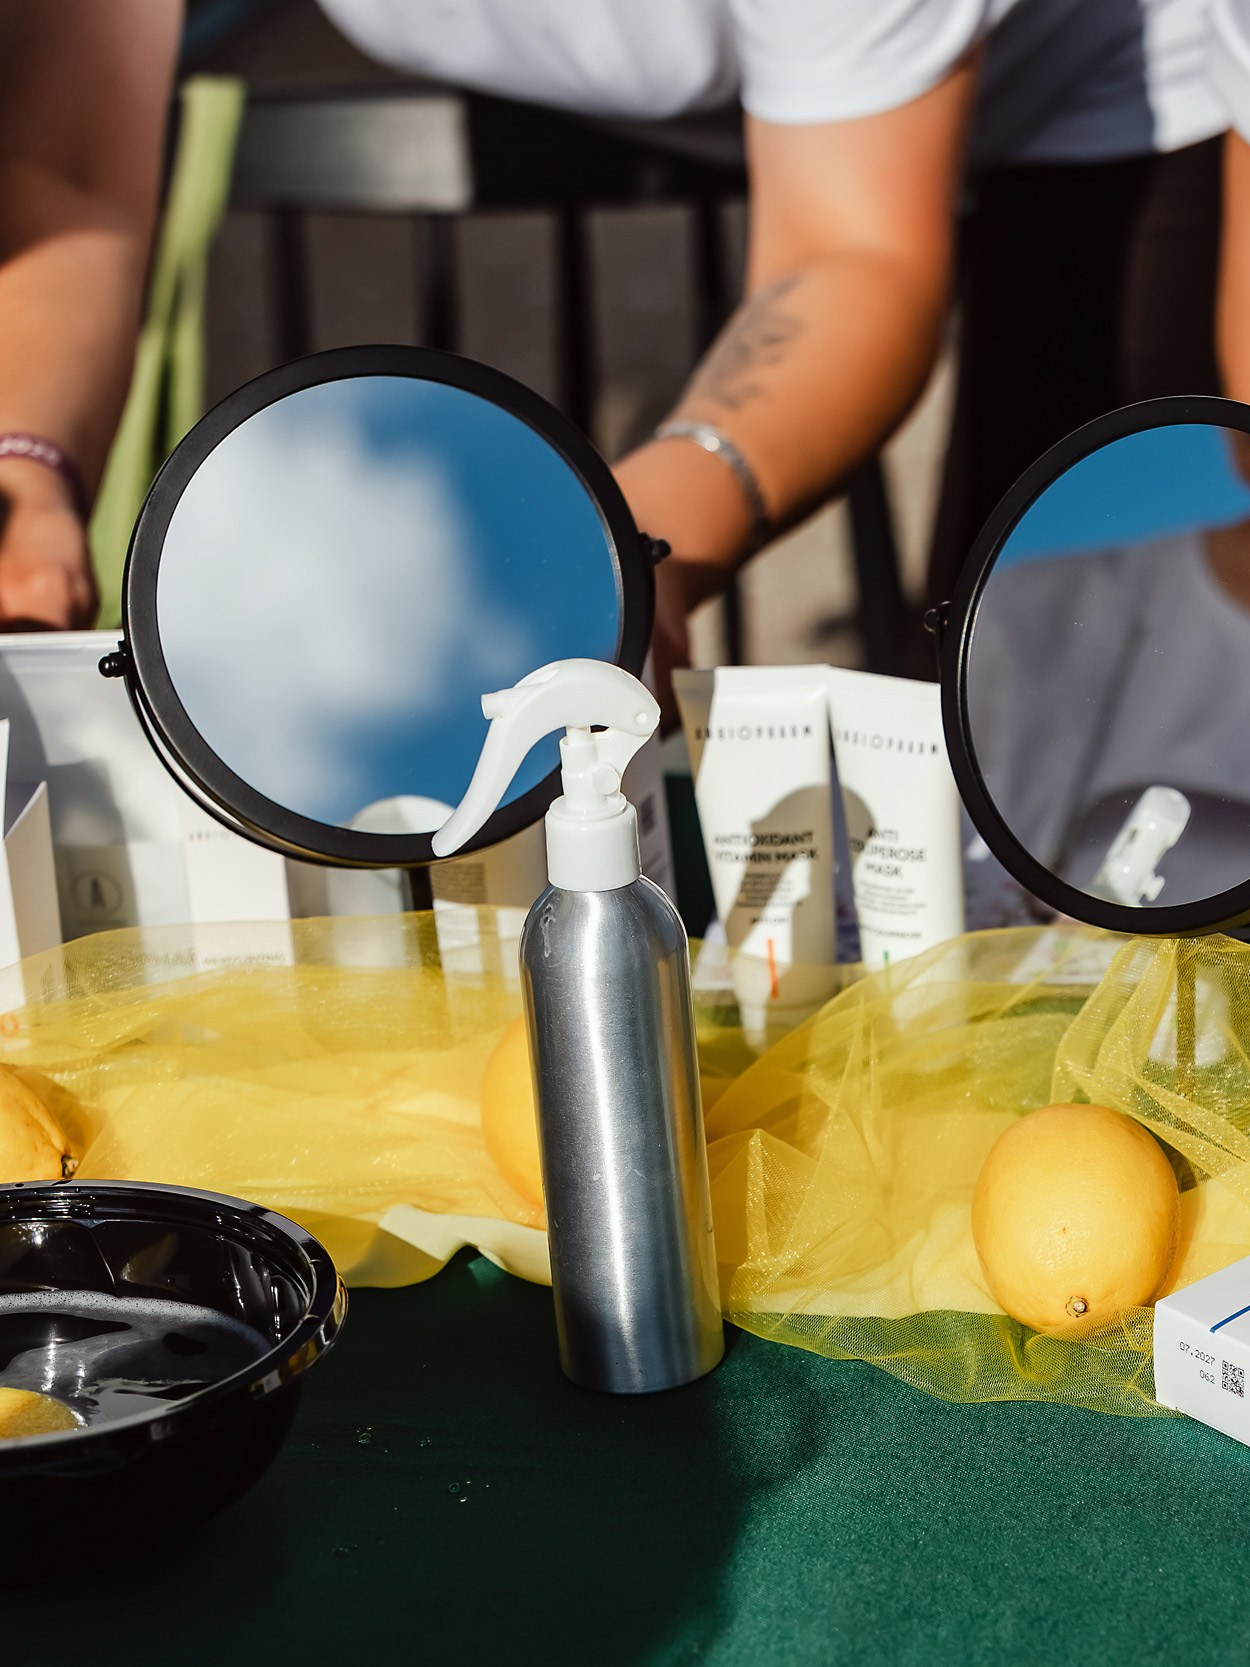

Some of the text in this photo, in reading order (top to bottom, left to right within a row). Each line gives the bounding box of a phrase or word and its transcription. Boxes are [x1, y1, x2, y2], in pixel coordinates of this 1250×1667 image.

[775, 848, 819, 862] MASK
[864, 863, 903, 878] MASK
[1179, 1341, 1216, 1365] 07.2027
[1199, 1369, 1216, 1385] 062
